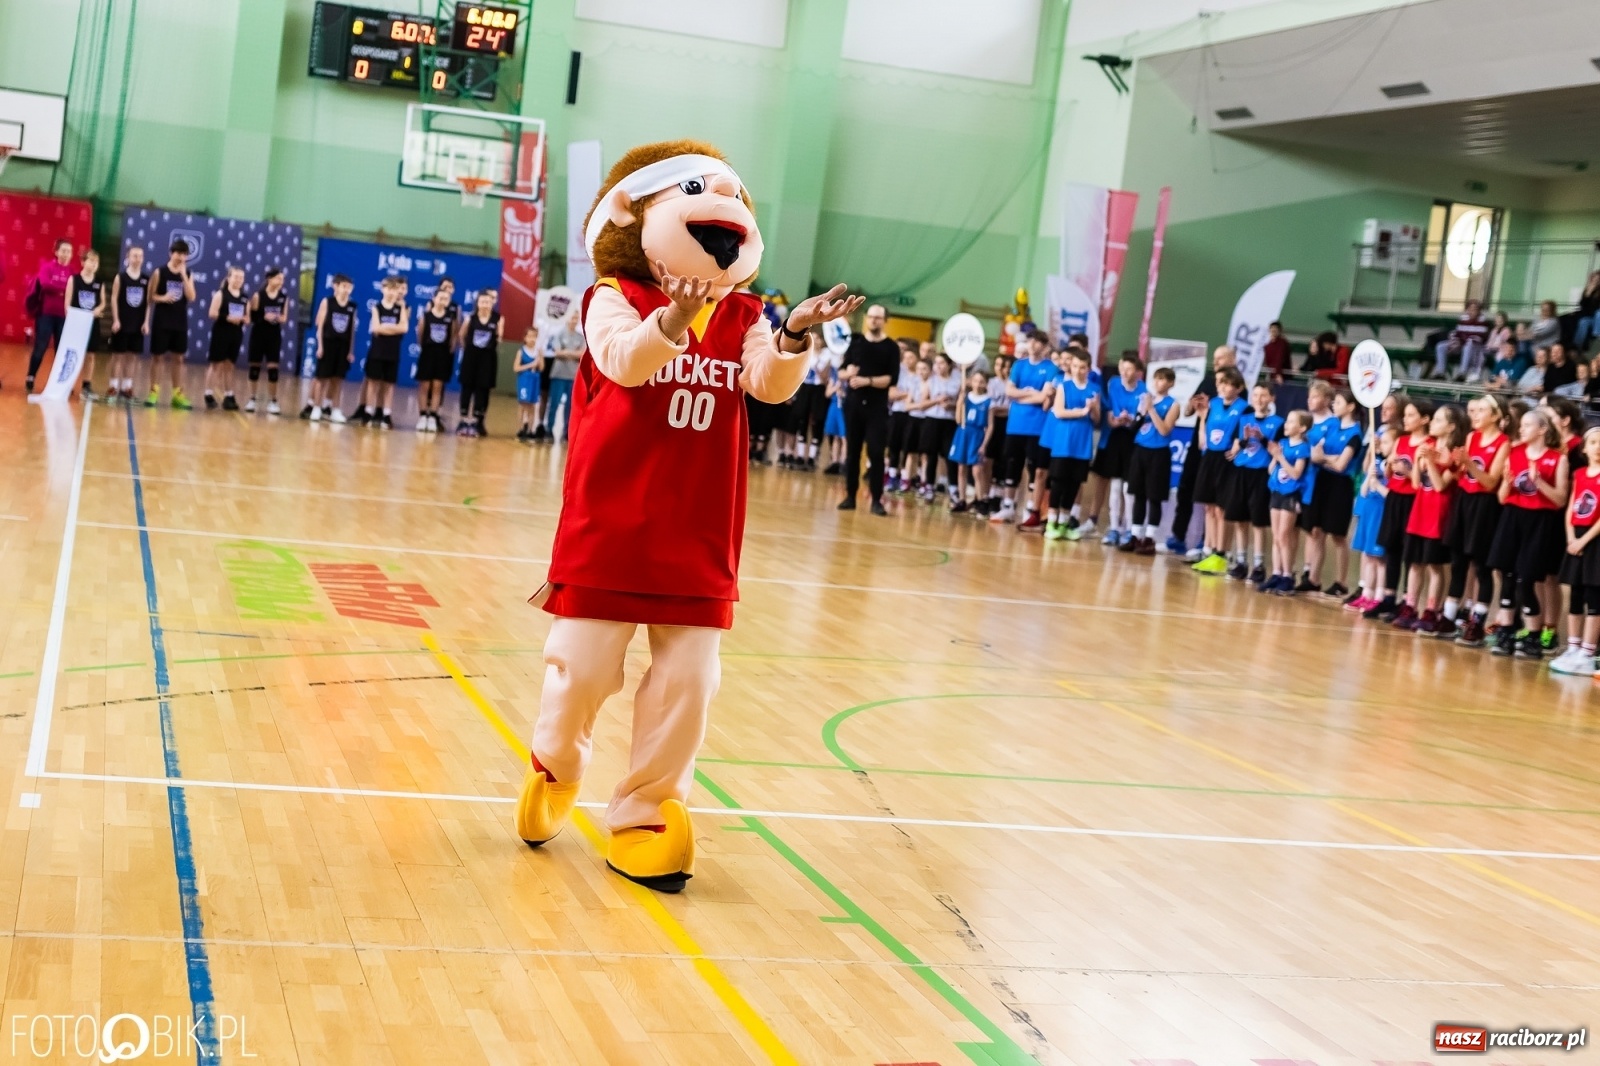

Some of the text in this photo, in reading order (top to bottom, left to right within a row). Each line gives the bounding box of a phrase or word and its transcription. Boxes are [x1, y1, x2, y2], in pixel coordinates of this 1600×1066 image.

[467, 26, 500, 50] 24
[354, 60, 369, 79] 0
[432, 71, 447, 90] 0
[639, 353, 742, 391] OCKET
[668, 388, 715, 431] 00
